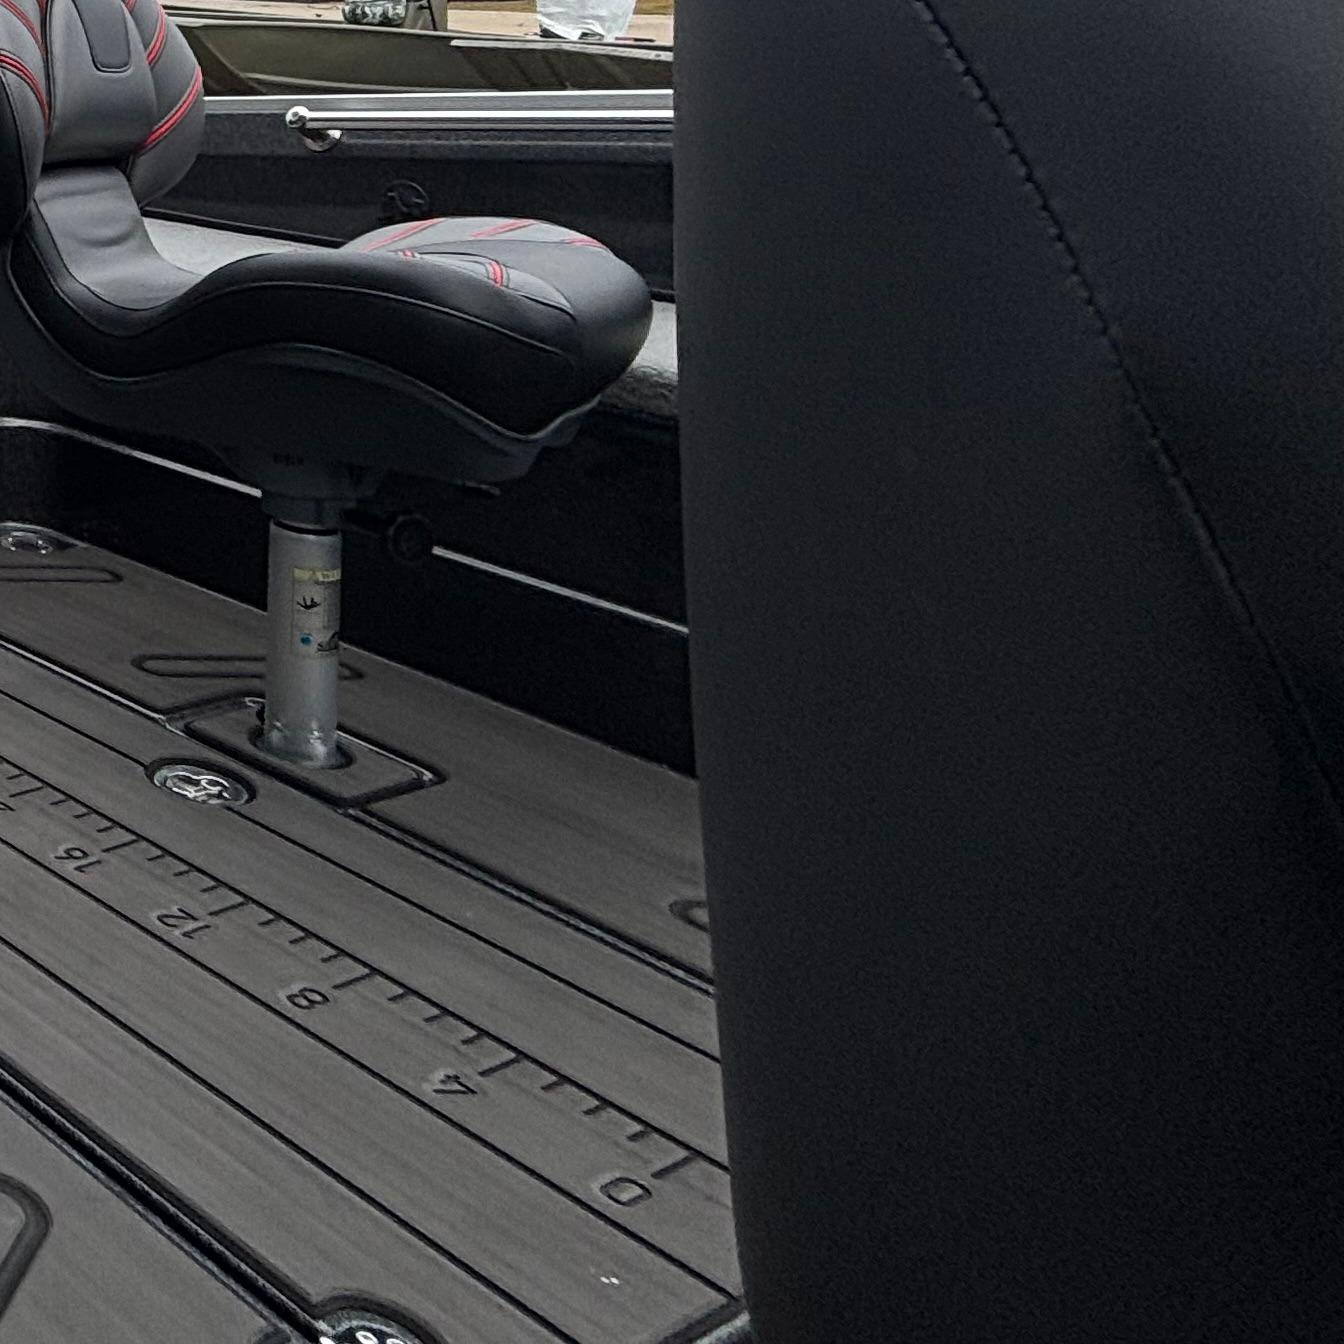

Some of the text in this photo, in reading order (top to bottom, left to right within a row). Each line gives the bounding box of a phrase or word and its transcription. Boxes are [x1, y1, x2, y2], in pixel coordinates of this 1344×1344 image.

[54, 846, 103, 874] 16
[156, 906, 211, 940] 12
[286, 987, 331, 1011] 8
[433, 1073, 479, 1098] 4
[599, 1176, 653, 1207] 0
